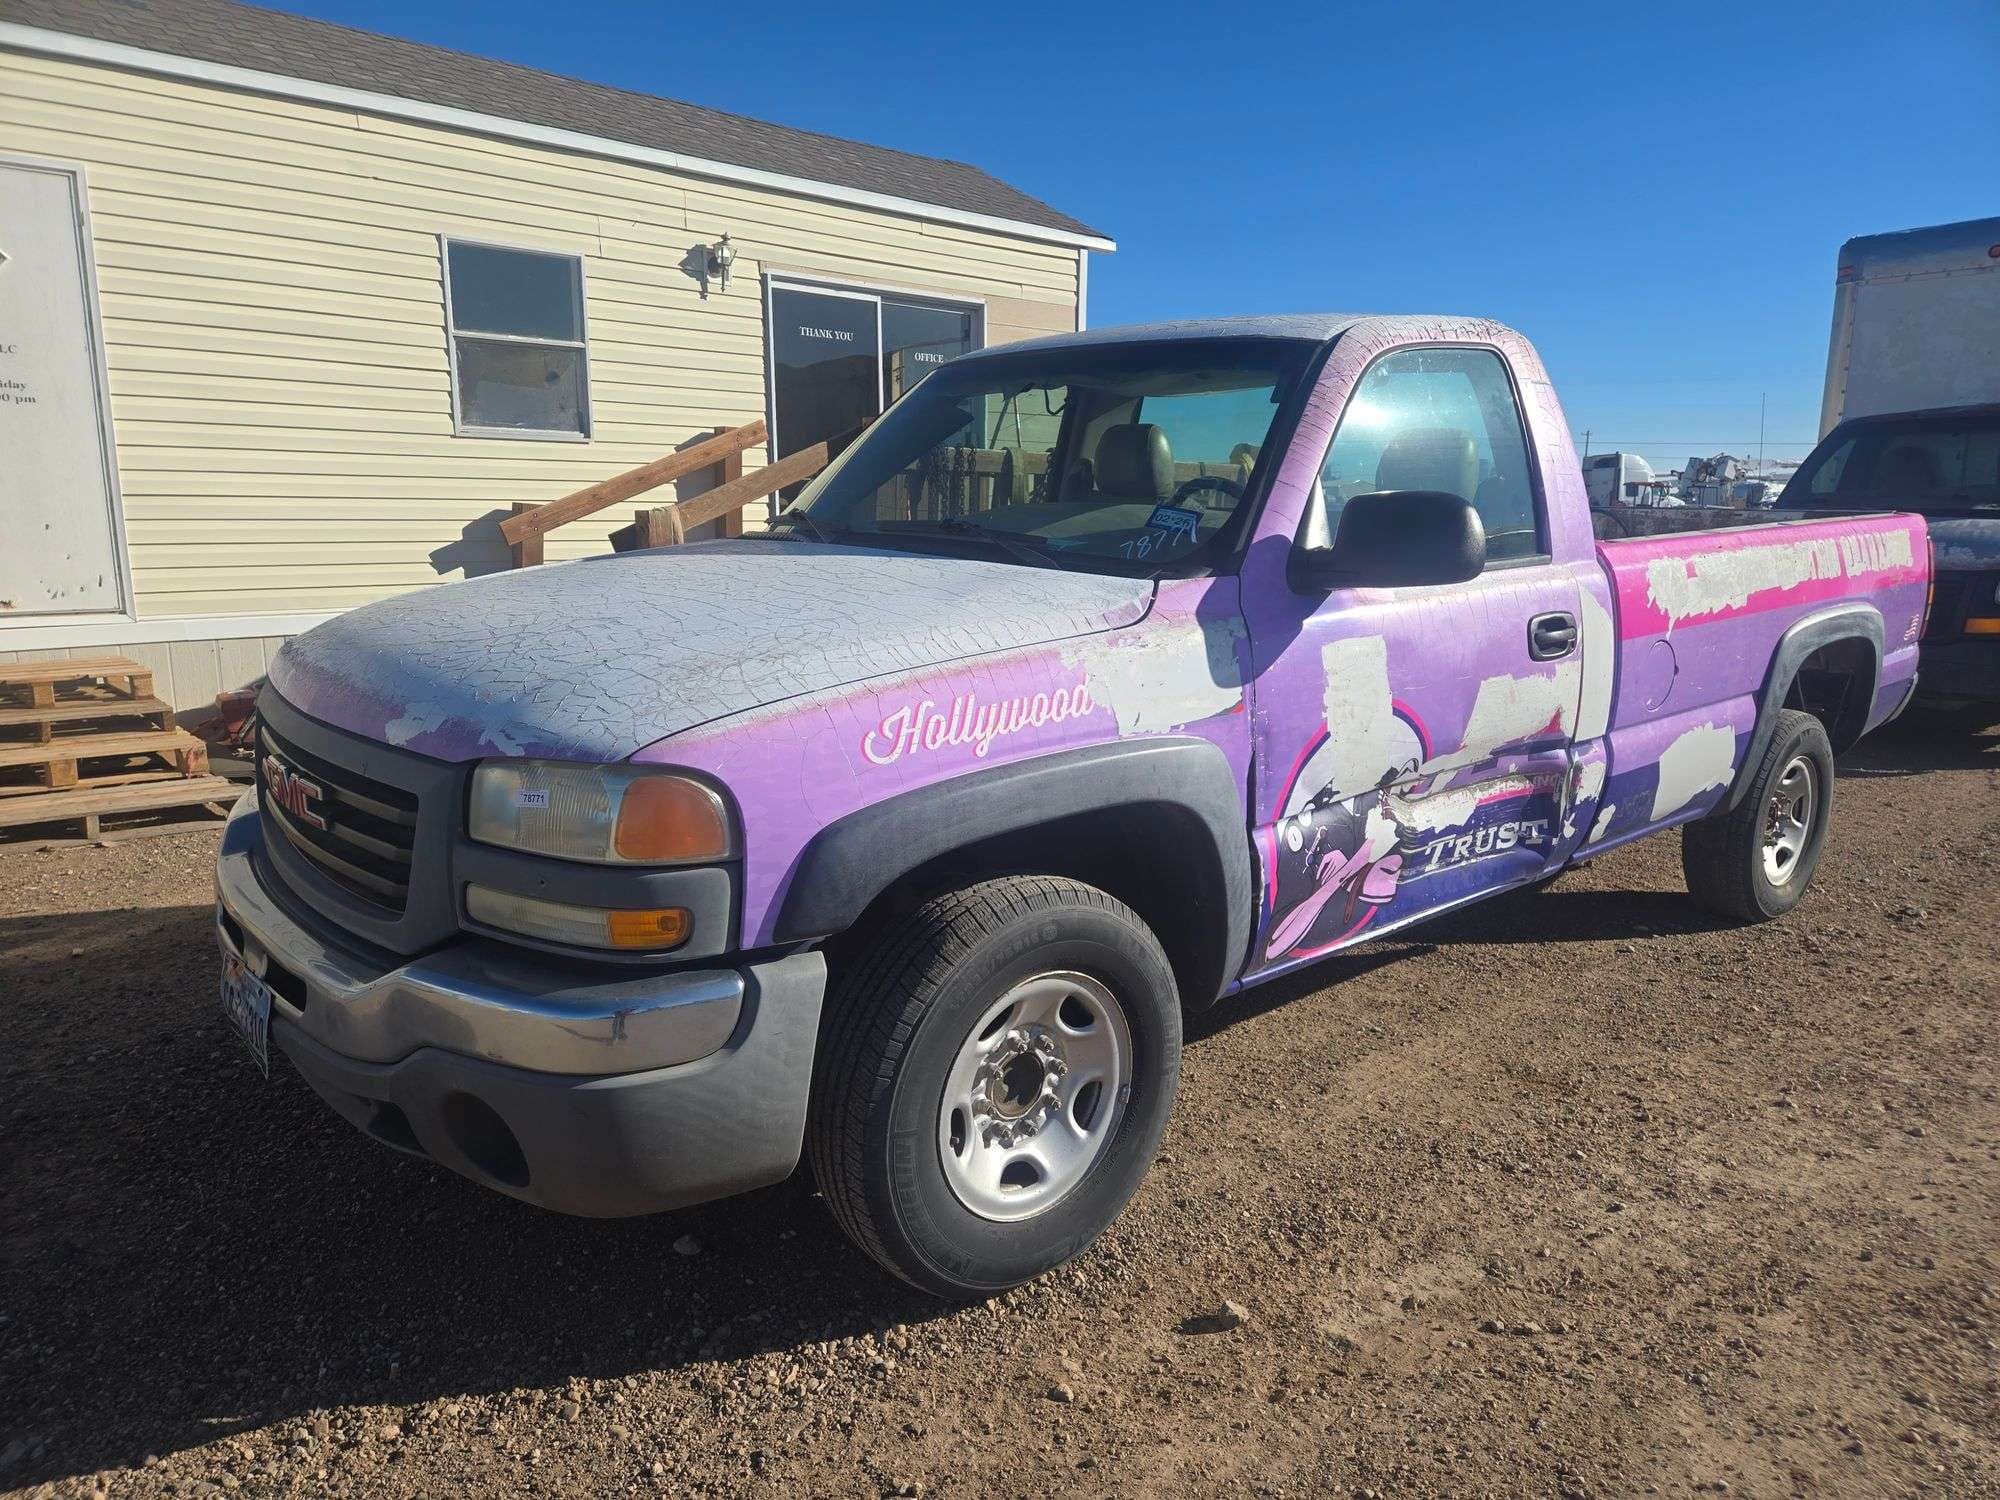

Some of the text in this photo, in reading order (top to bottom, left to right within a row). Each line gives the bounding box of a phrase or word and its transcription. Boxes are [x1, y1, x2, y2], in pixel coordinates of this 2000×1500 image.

[799, 326, 854, 342] THANK YOU
[914, 352, 944, 363] OFFICE
[15, 396, 36, 405] pm
[860, 673, 1098, 767] Hollywood
[262, 755, 327, 832] GMC
[523, 793, 545, 803] 78771
[1424, 818, 1549, 872] TRUST
